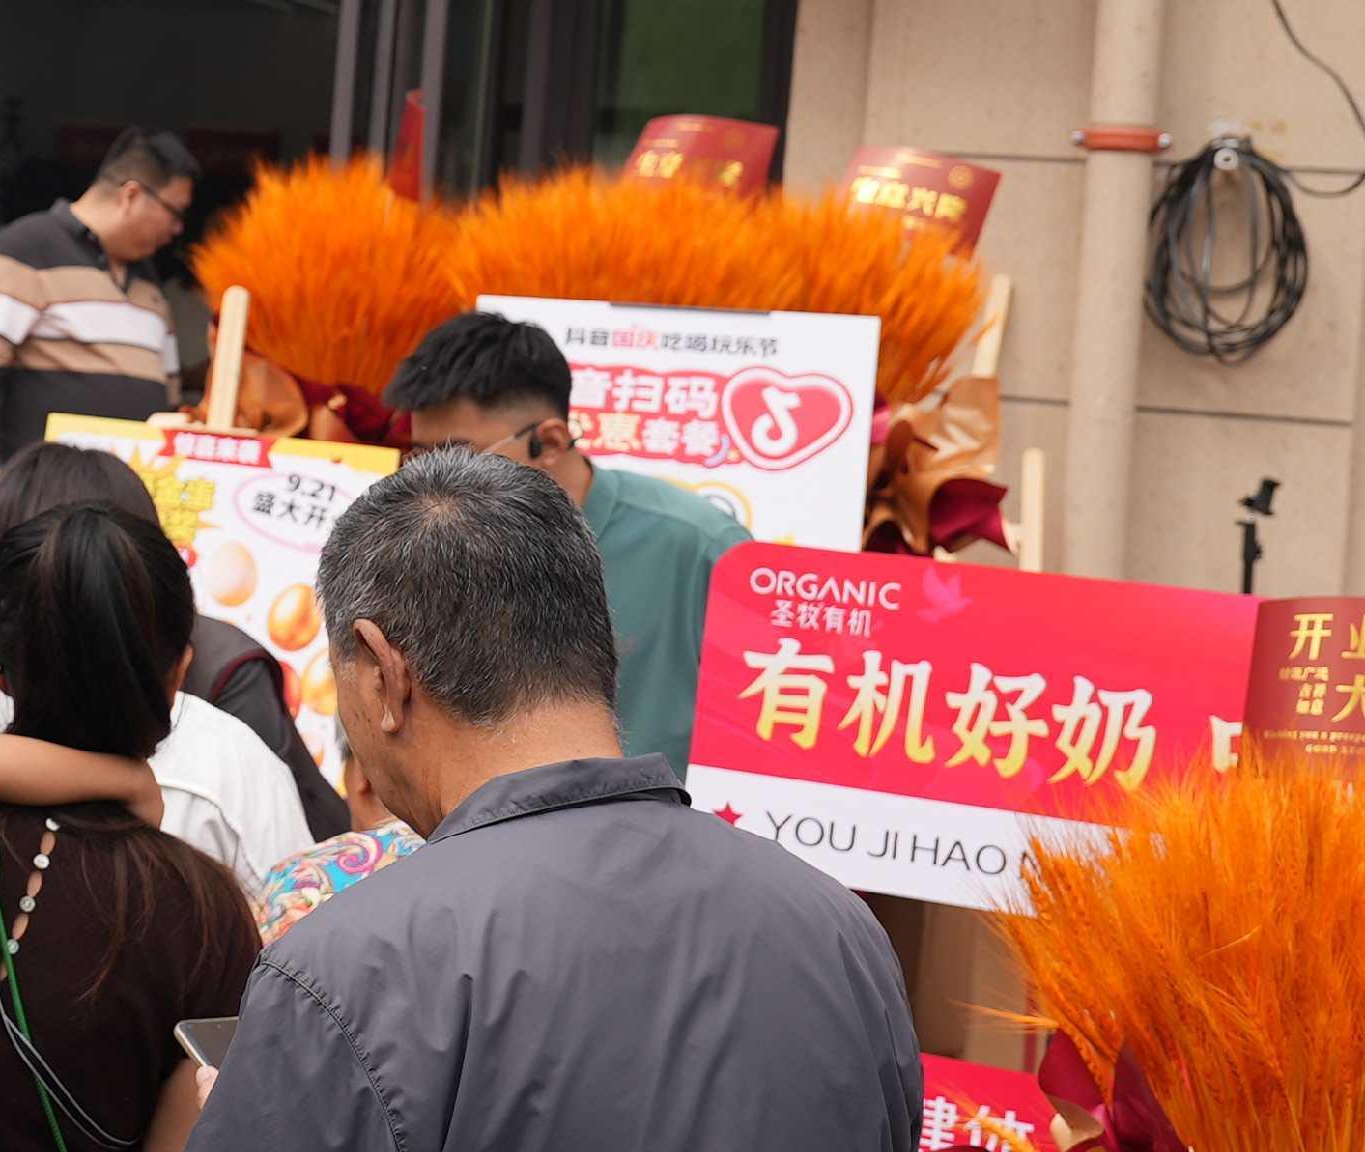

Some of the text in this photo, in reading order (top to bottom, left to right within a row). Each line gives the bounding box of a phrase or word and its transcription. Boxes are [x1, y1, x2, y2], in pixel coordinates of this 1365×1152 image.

[286, 473, 337, 502] 9.21
[749, 567, 902, 611] ORGANIC
[769, 599, 871, 638] 圣牧有机
[737, 637, 1158, 792] 有机好奶
[766, 810, 858, 853] YOU
[866, 829, 899, 860] JI
[910, 833, 1008, 876] HAO
